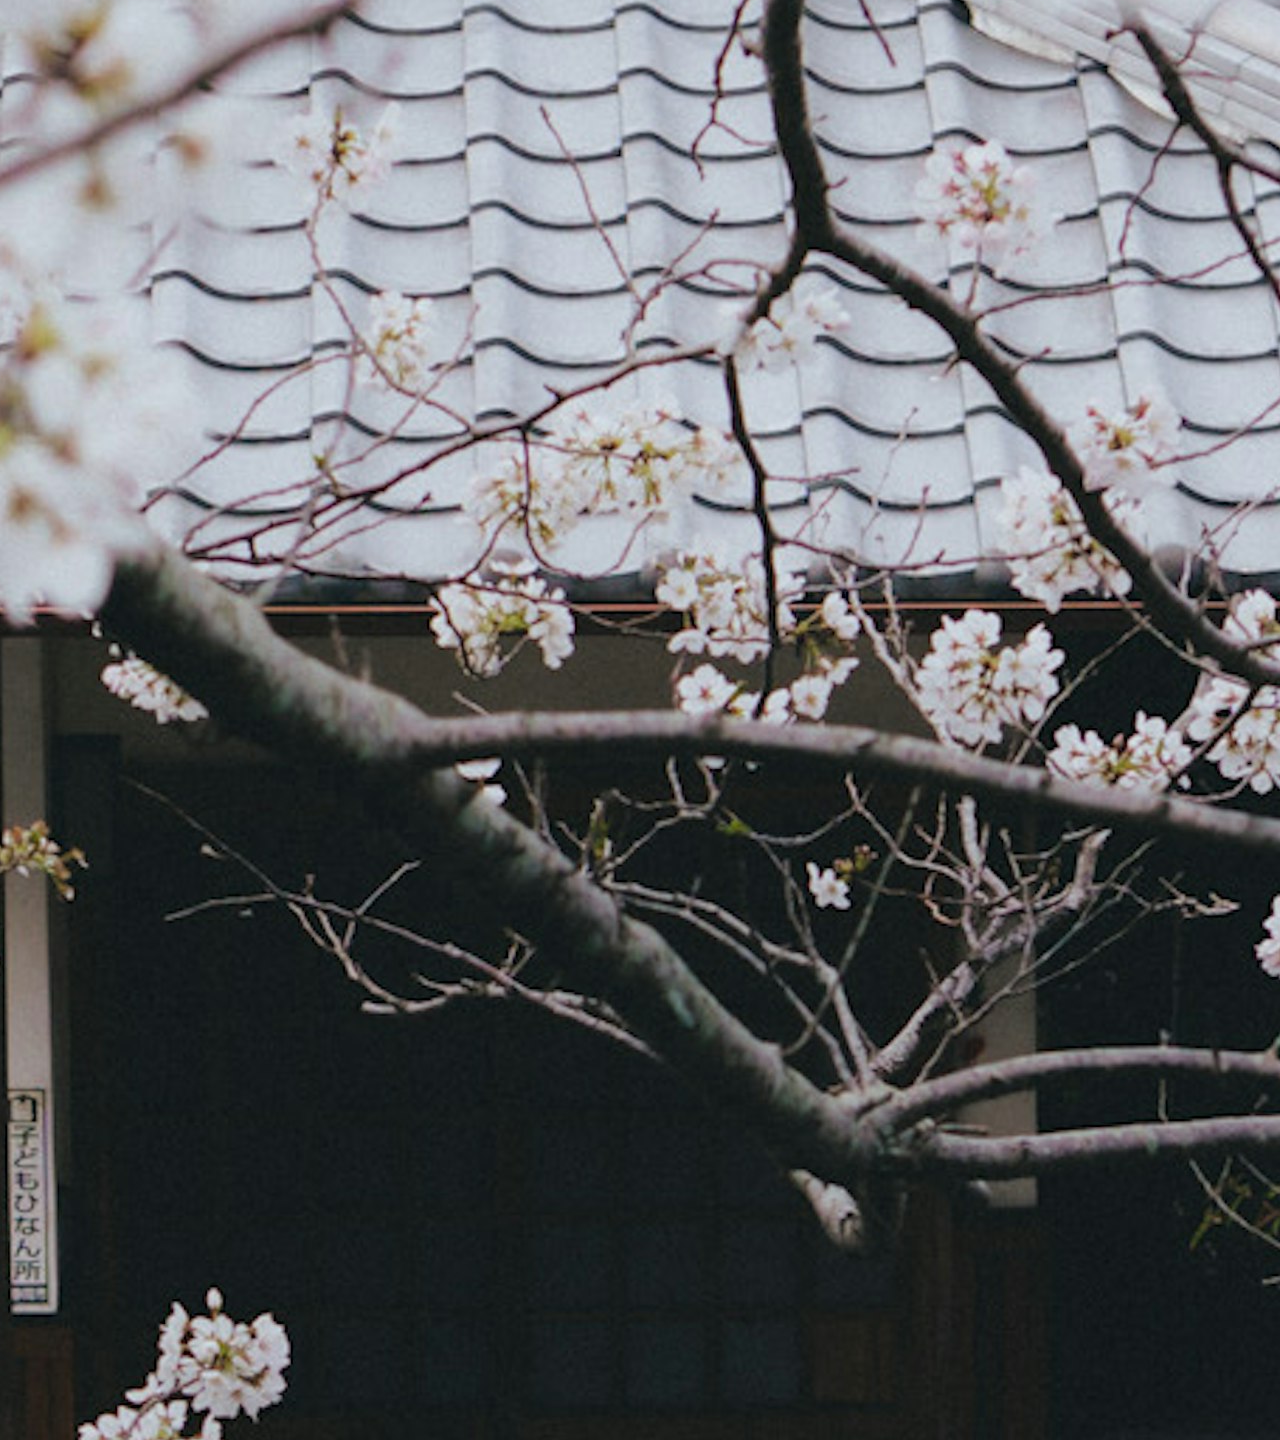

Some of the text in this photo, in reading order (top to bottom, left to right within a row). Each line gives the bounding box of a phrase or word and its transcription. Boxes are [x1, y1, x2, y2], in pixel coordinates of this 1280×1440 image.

[13, 1126, 41, 1280] 子どもひなん所
